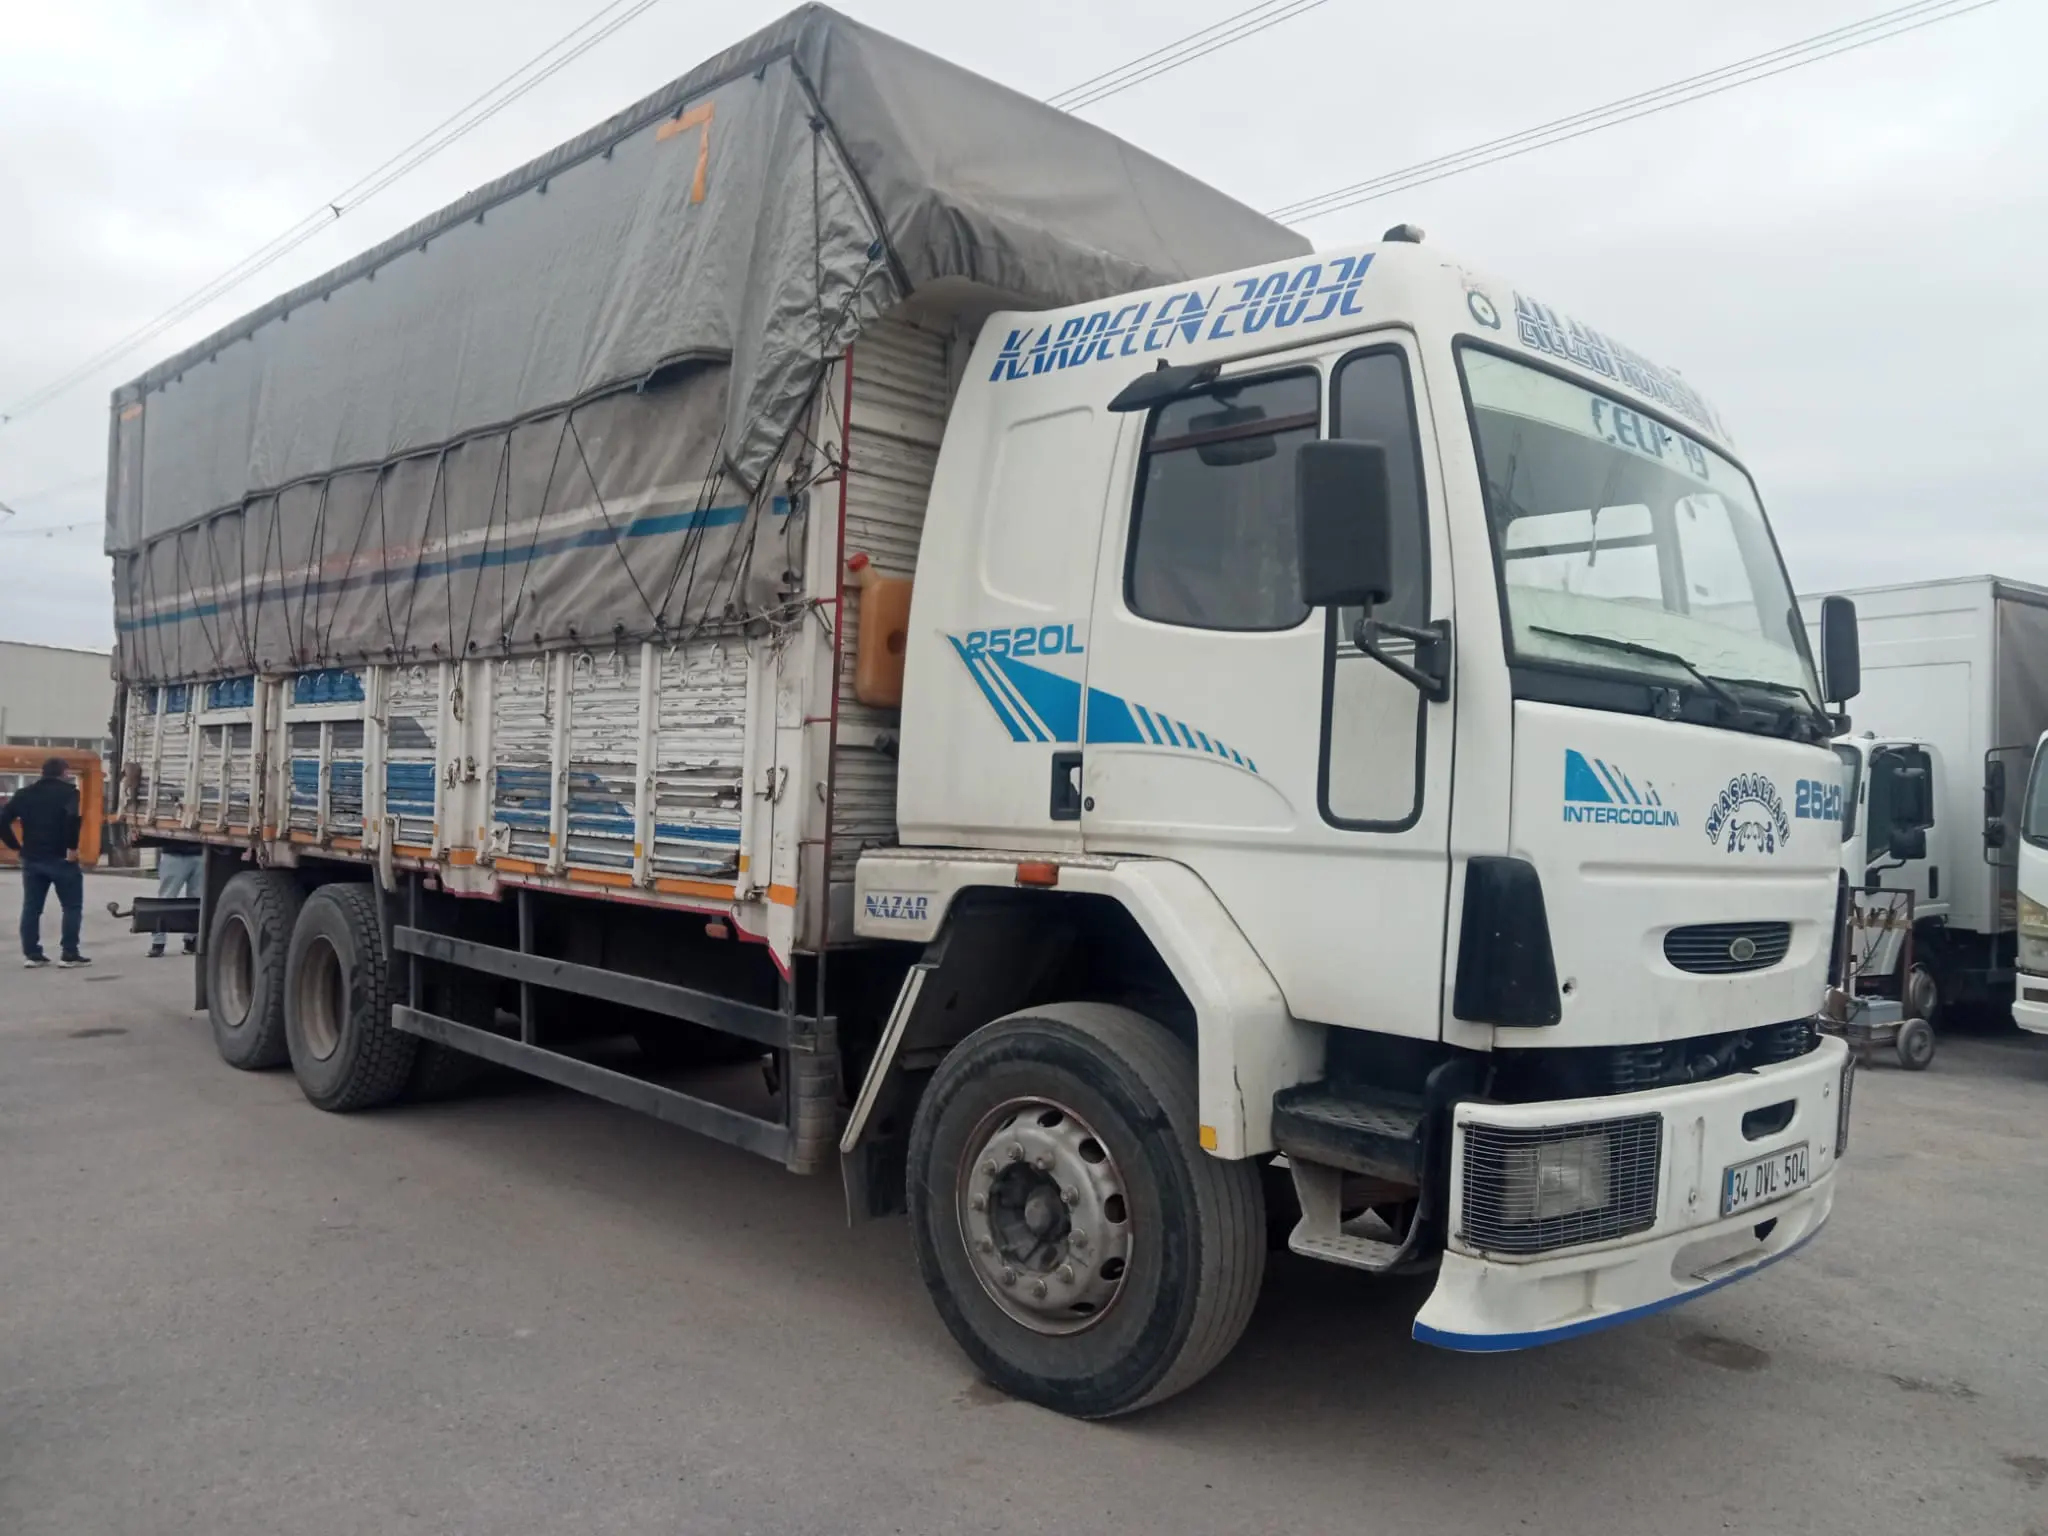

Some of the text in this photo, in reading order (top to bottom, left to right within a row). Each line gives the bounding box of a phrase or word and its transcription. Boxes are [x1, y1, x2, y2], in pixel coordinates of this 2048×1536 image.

[988, 286, 1220, 382] KARDELEN
[966, 623, 1084, 658] 2520L
[864, 895, 928, 920] NAZAR
[1732, 1150, 1806, 1205] 34 DVL 504
